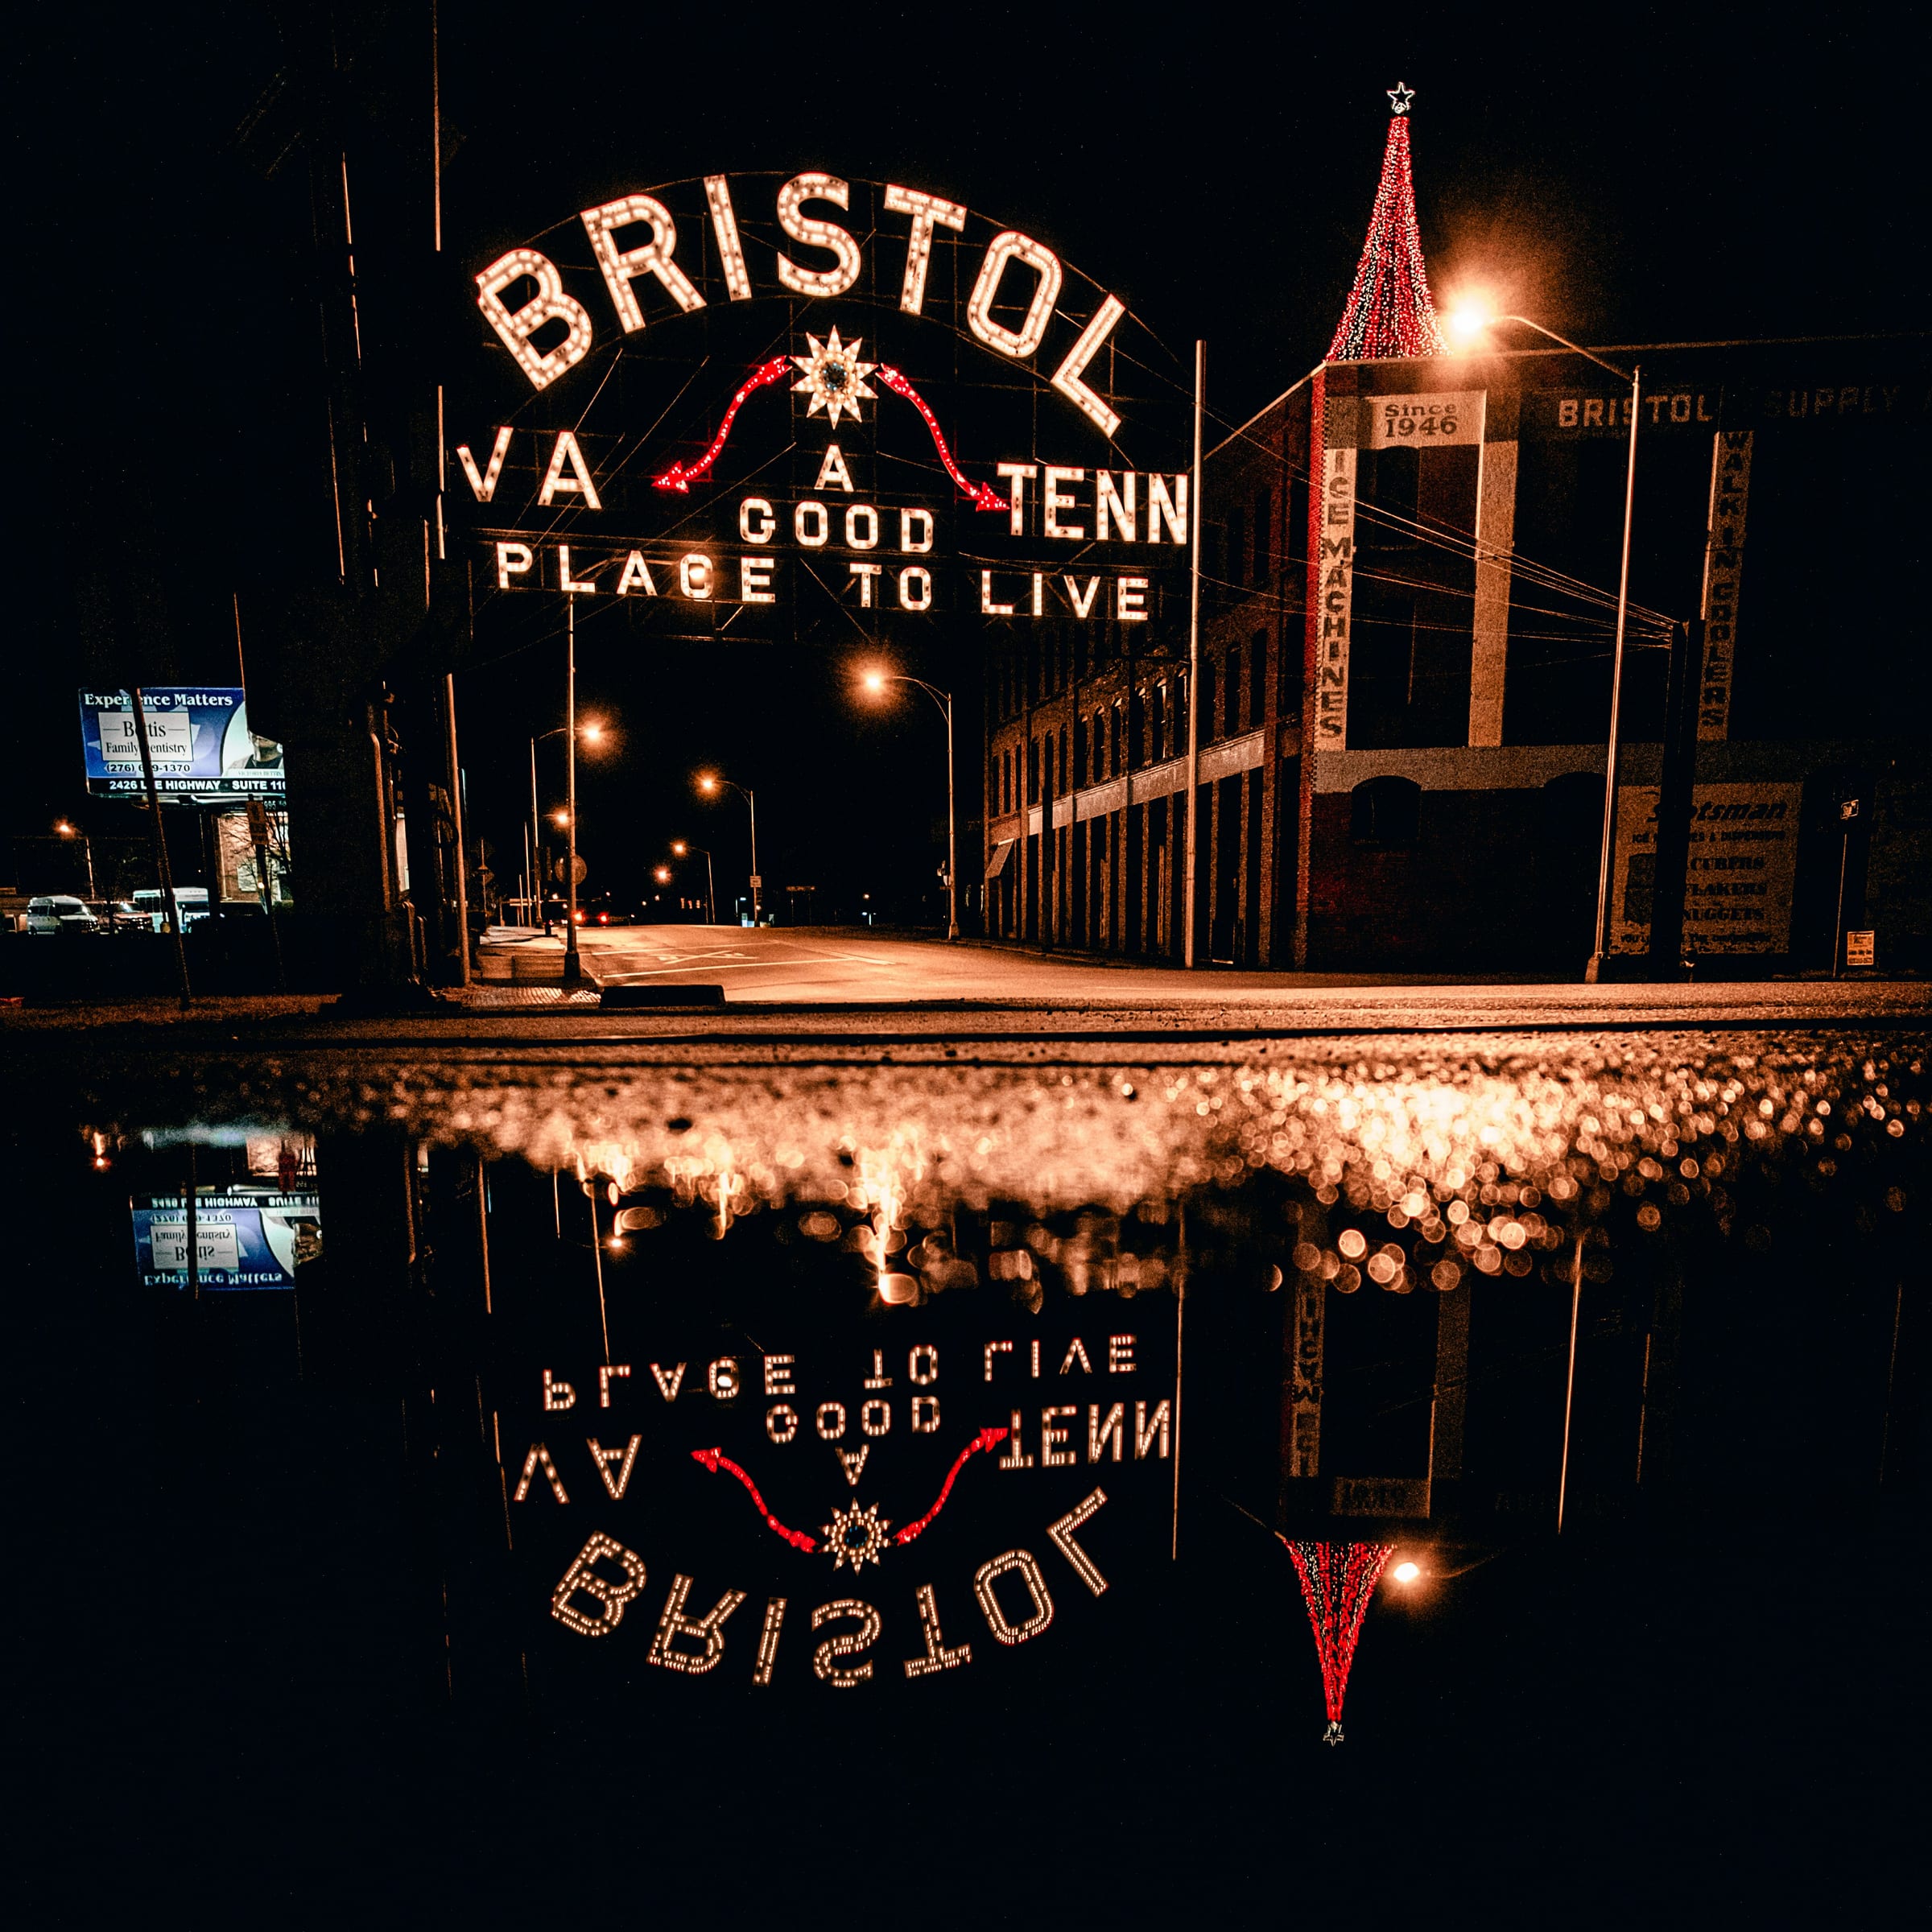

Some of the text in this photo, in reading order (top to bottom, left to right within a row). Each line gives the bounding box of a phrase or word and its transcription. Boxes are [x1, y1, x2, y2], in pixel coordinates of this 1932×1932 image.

[474, 171, 1126, 441] BRISTOL
[1385, 403, 1457, 418] Since
[1385, 416, 1458, 438] 1946
[1558, 394, 1714, 427] BRISTOL
[456, 426, 602, 510] VA
[814, 444, 855, 492] A
[996, 461, 1188, 545] TENN
[739, 497, 934, 555] GOOD
[496, 542, 1149, 622] PLACE TO LIVE
[1319, 450, 1352, 738] ICE MACHINES
[85, 693, 233, 708] Expernce Matters
[122, 720, 167, 737] Btis
[105, 741, 188, 756] Family entistry
[106, 764, 191, 773] (276) 69-1370
[109, 781, 138, 790] 2426
[140, 781, 163, 791] LE
[165, 781, 221, 791] HIGHWAY
[232, 781, 268, 791] SUITE
